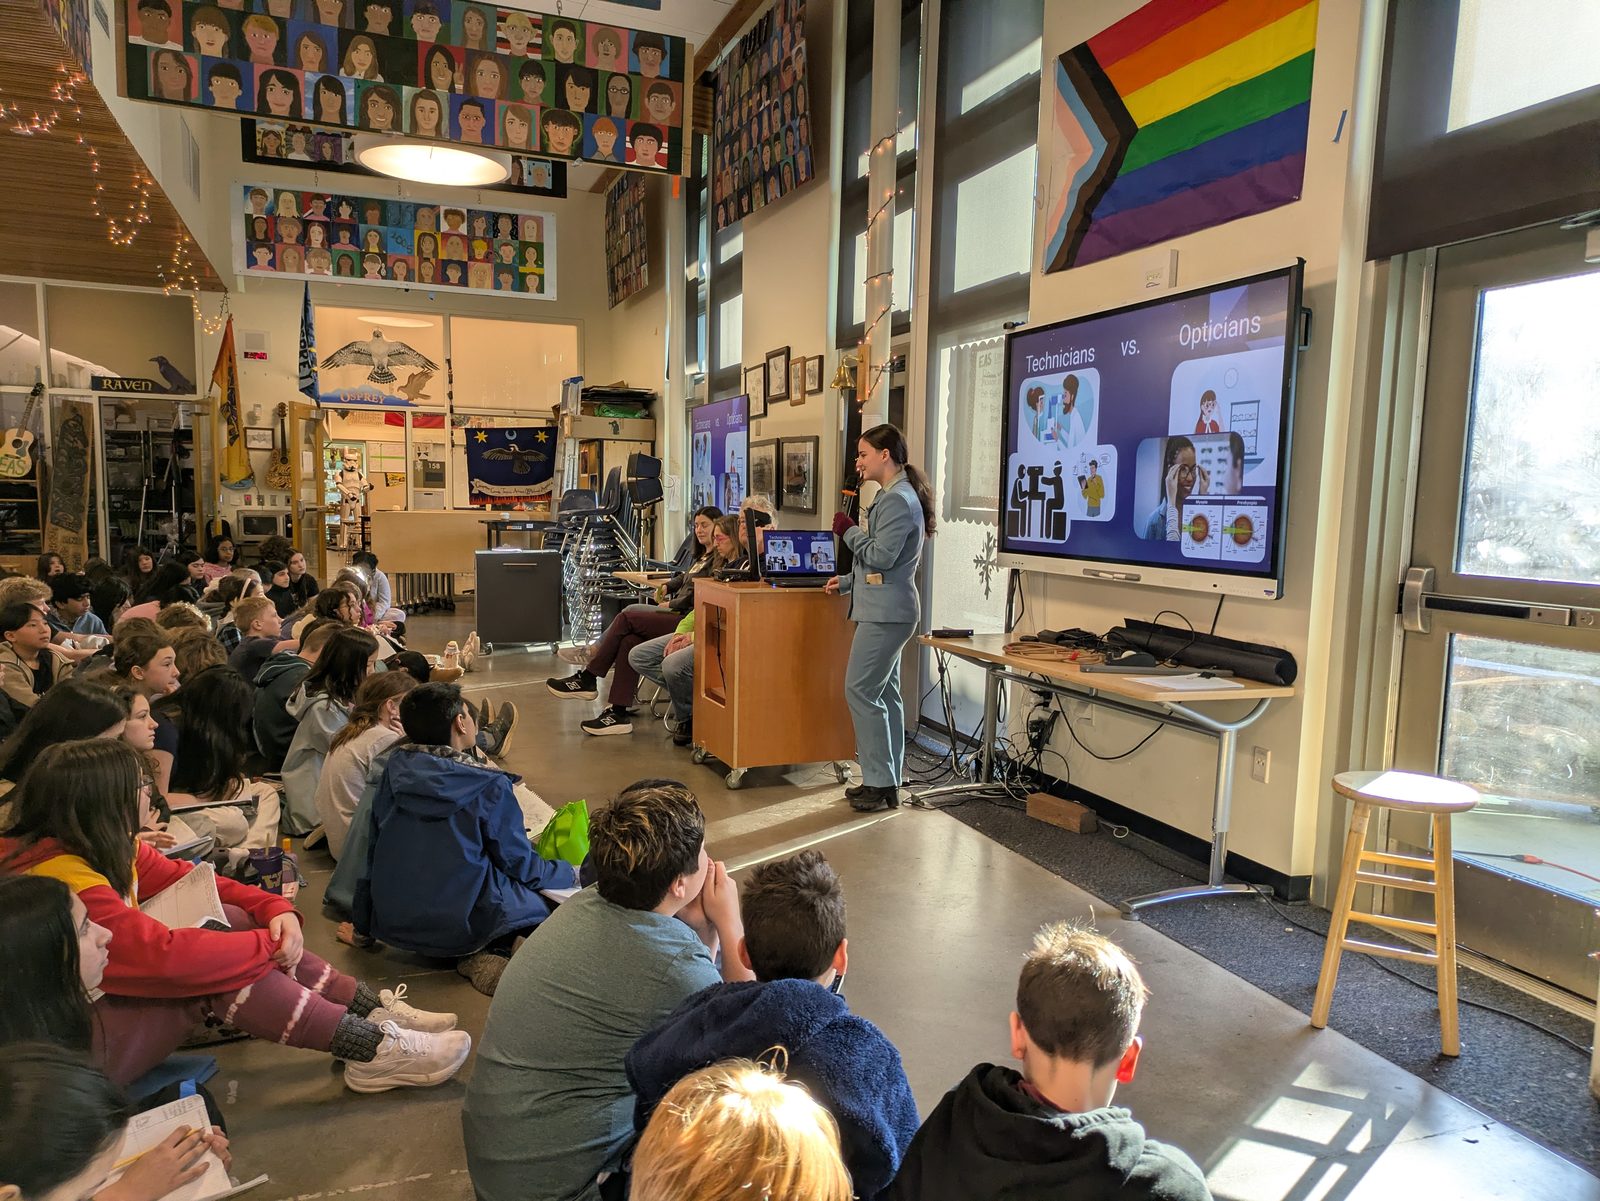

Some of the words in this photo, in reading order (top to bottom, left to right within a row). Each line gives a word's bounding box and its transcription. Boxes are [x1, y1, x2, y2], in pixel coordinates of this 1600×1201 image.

[1026, 346, 1095, 373] Technicians
[1179, 315, 1261, 349] Opticians
[978, 352, 992, 368] EAS
[102, 379, 152, 391] RAVEN
[340, 390, 385, 404] OSPREY
